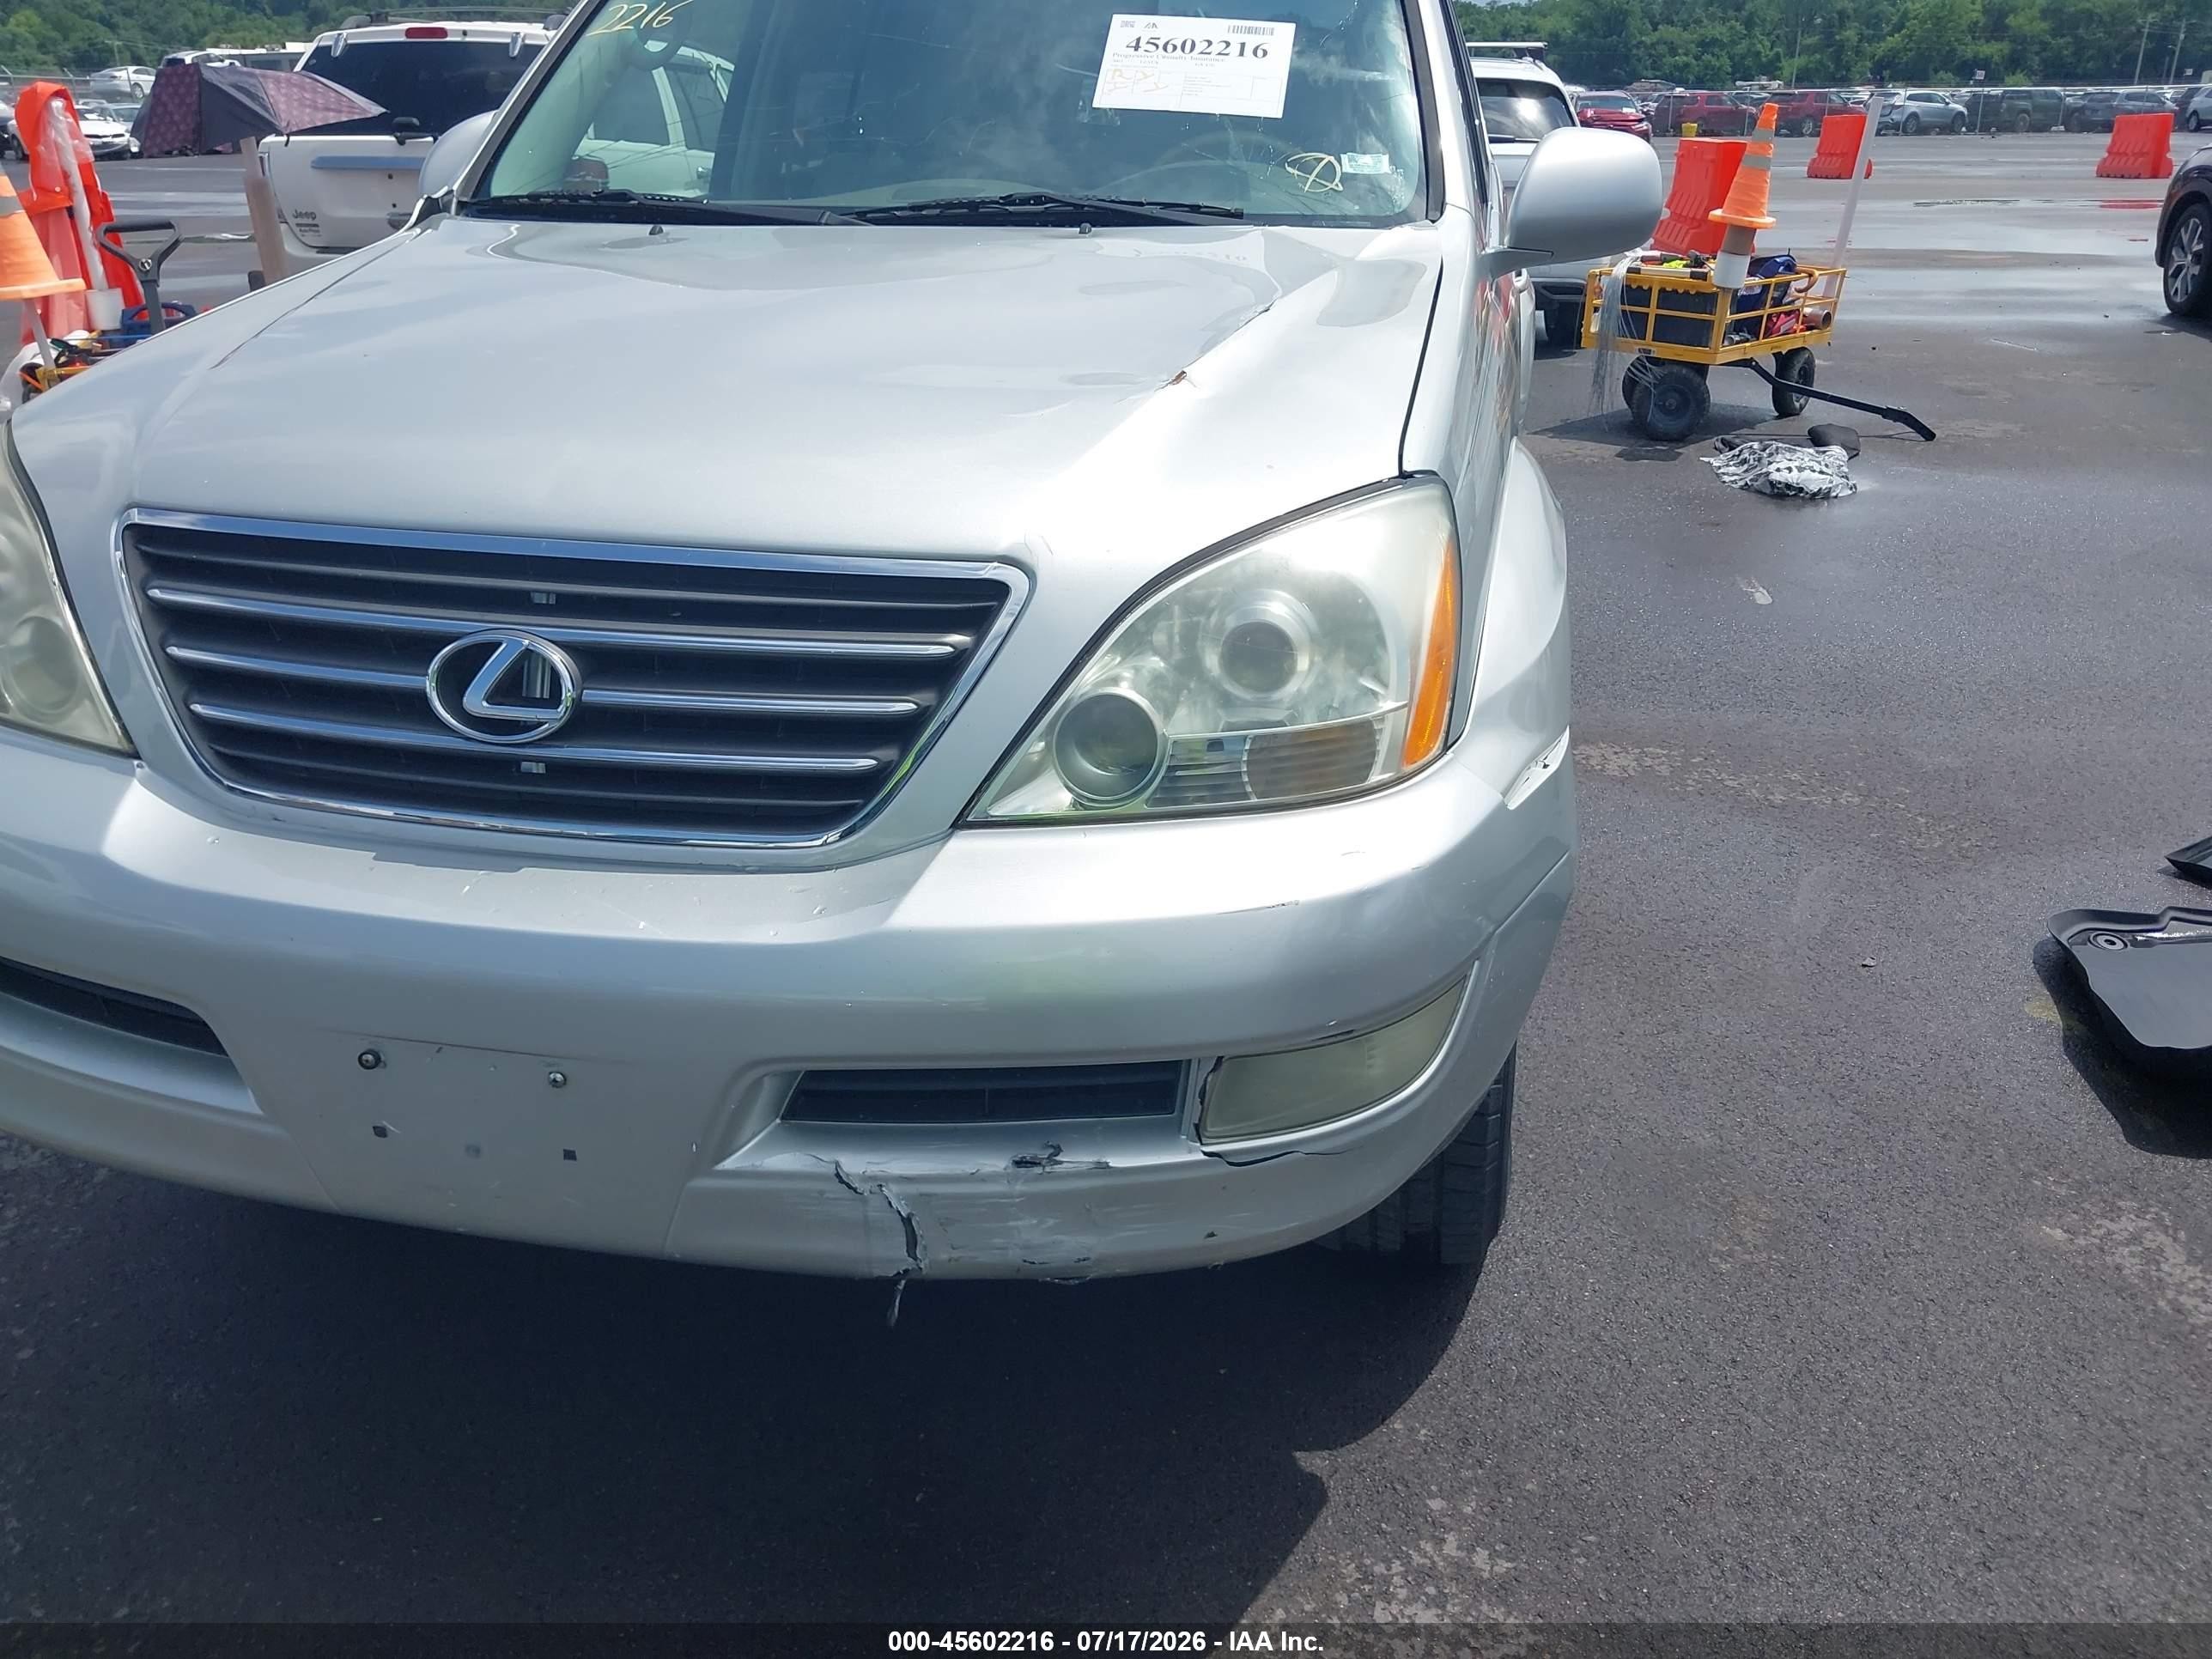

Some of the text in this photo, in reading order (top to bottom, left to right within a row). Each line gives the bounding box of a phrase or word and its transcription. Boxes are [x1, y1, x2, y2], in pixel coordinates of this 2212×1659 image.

[585, 0, 694, 36] 2216
[1125, 35, 1272, 59] 45602216
[292, 209, 317, 221] Jeep
